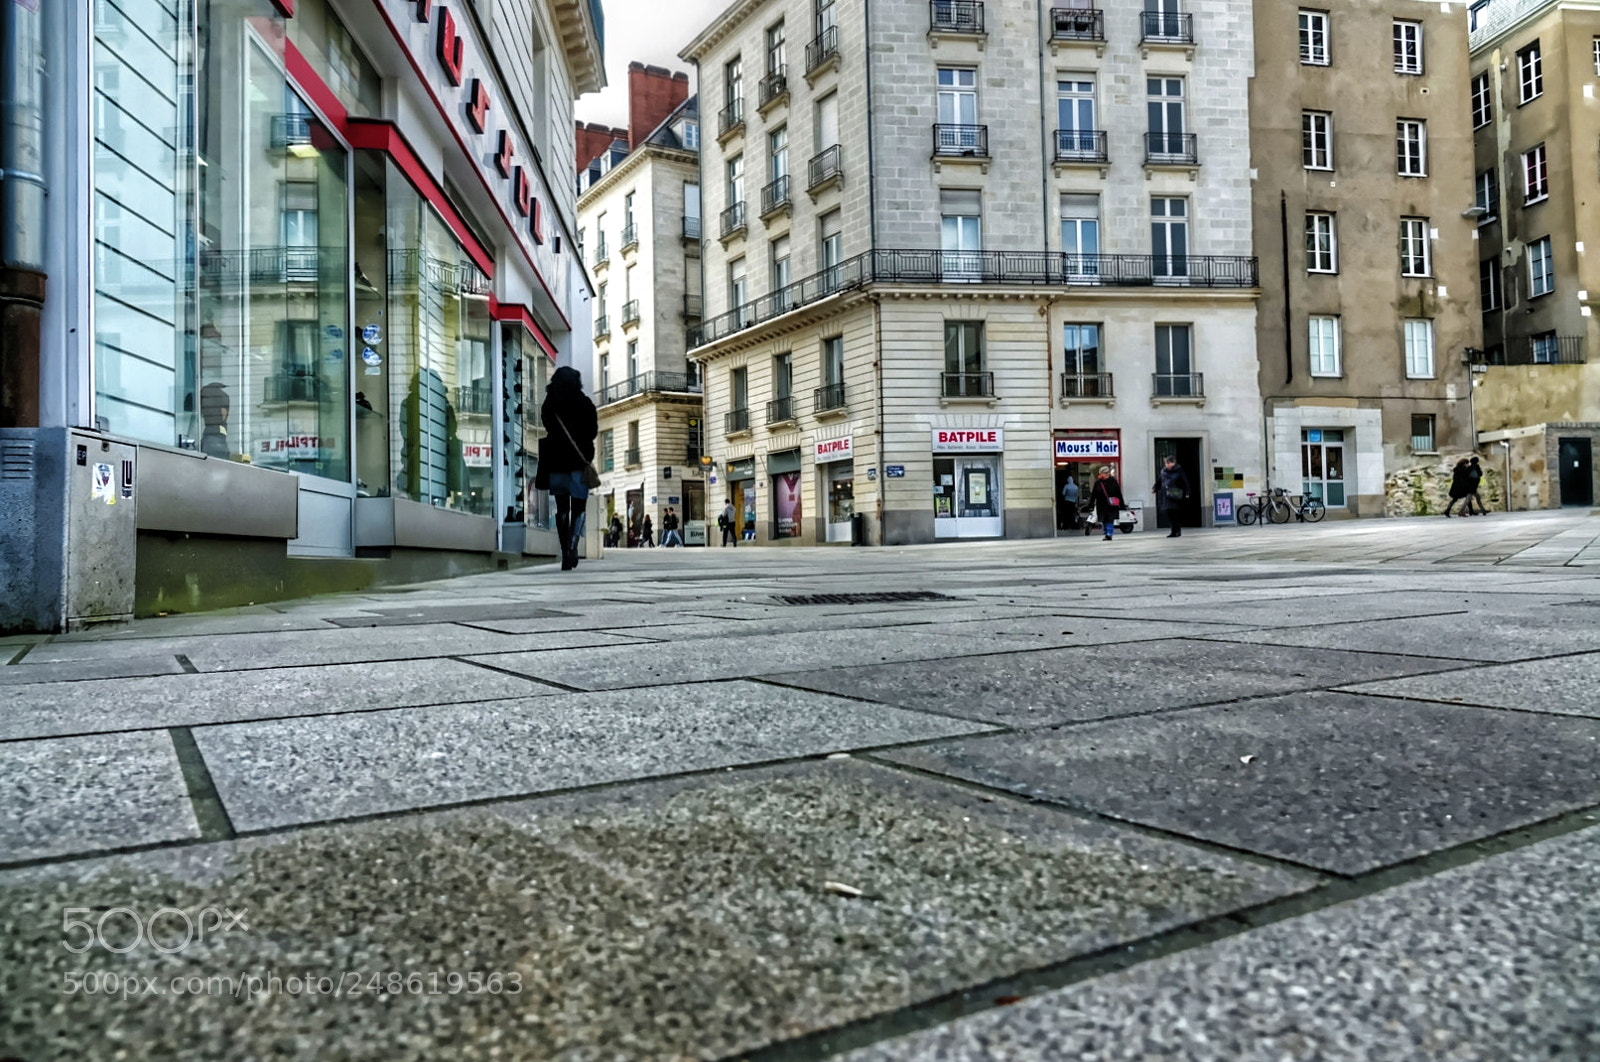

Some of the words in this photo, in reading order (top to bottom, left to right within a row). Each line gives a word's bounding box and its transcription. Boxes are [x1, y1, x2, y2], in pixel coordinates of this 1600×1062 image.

[938, 431, 997, 443] BATPILE
[817, 439, 849, 455] BATPILE
[1096, 441, 1118, 453] Hair
